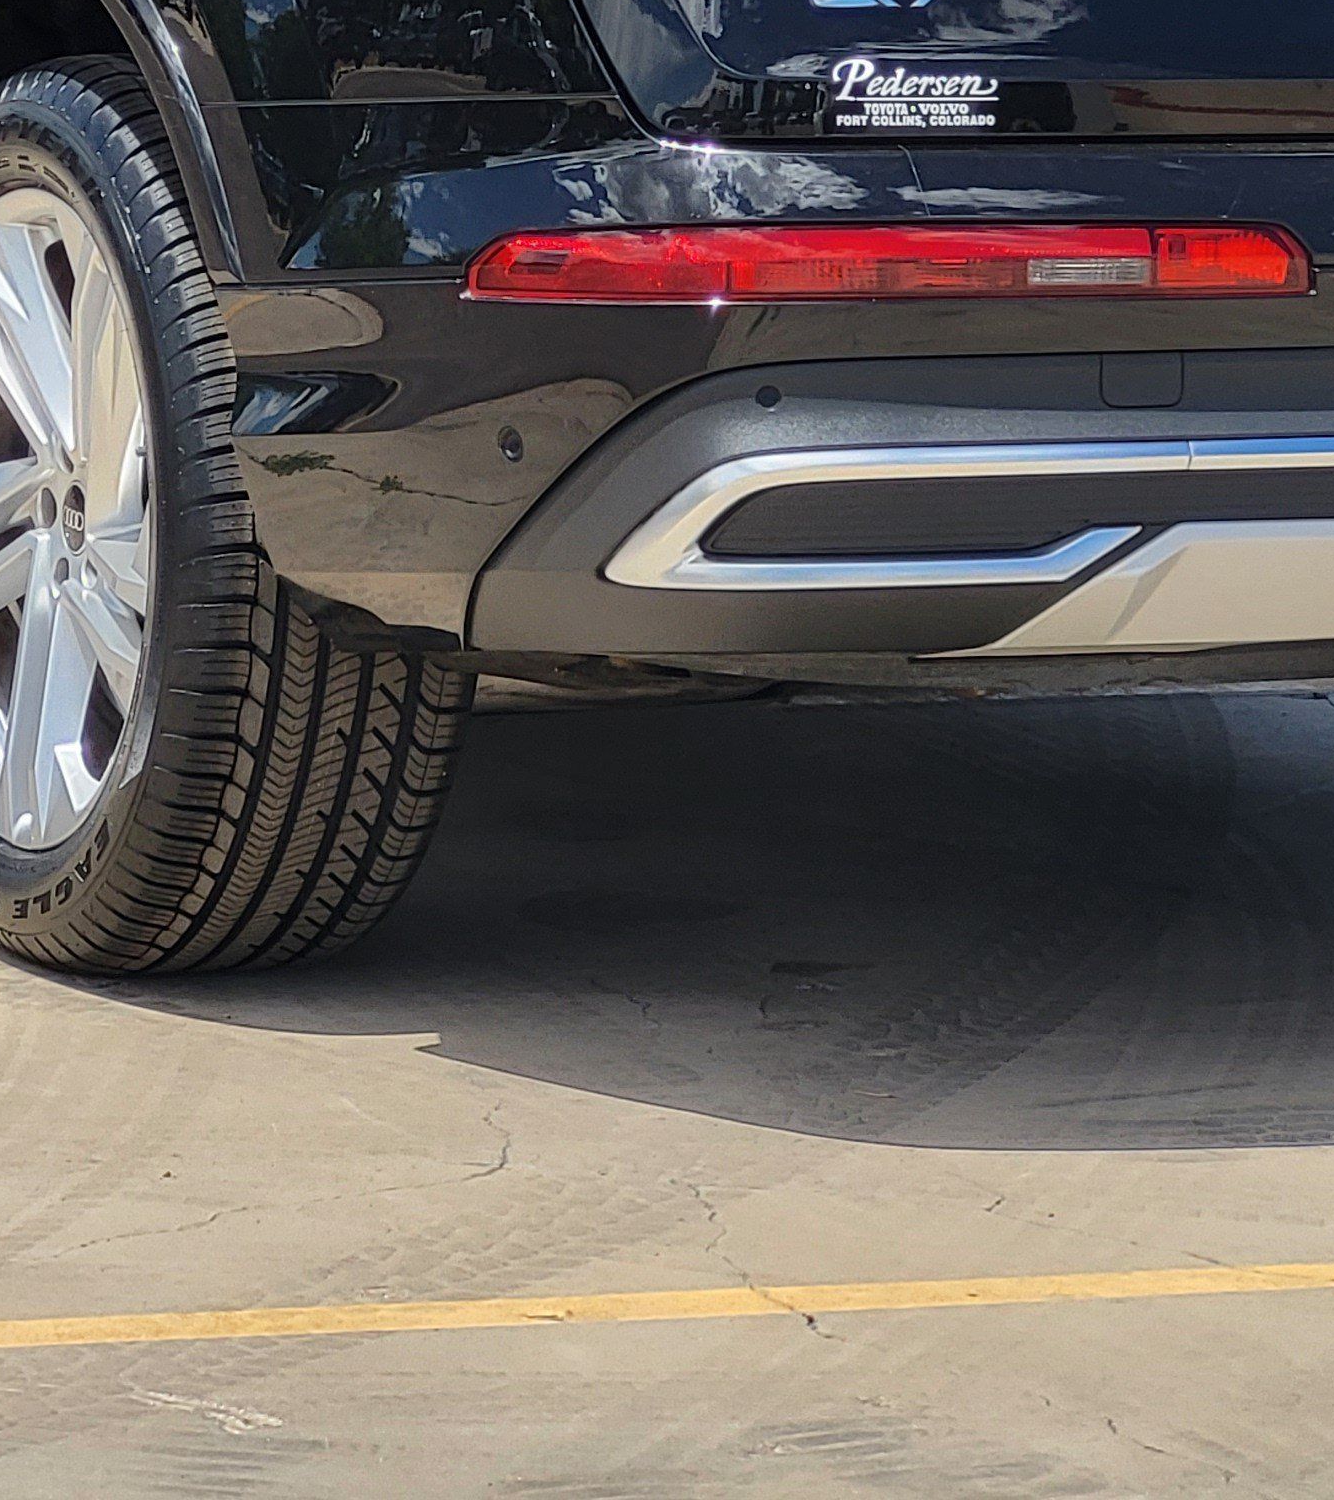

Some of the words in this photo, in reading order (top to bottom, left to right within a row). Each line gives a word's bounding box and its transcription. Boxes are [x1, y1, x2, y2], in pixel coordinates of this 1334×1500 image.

[832, 58, 999, 102] Pedersen
[835, 115, 868, 127] FORT
[929, 115, 996, 127] COLORADO
[864, 103, 909, 115] TOYOTA
[918, 103, 970, 115] VOLVO
[12, 818, 111, 919] EAGLE
